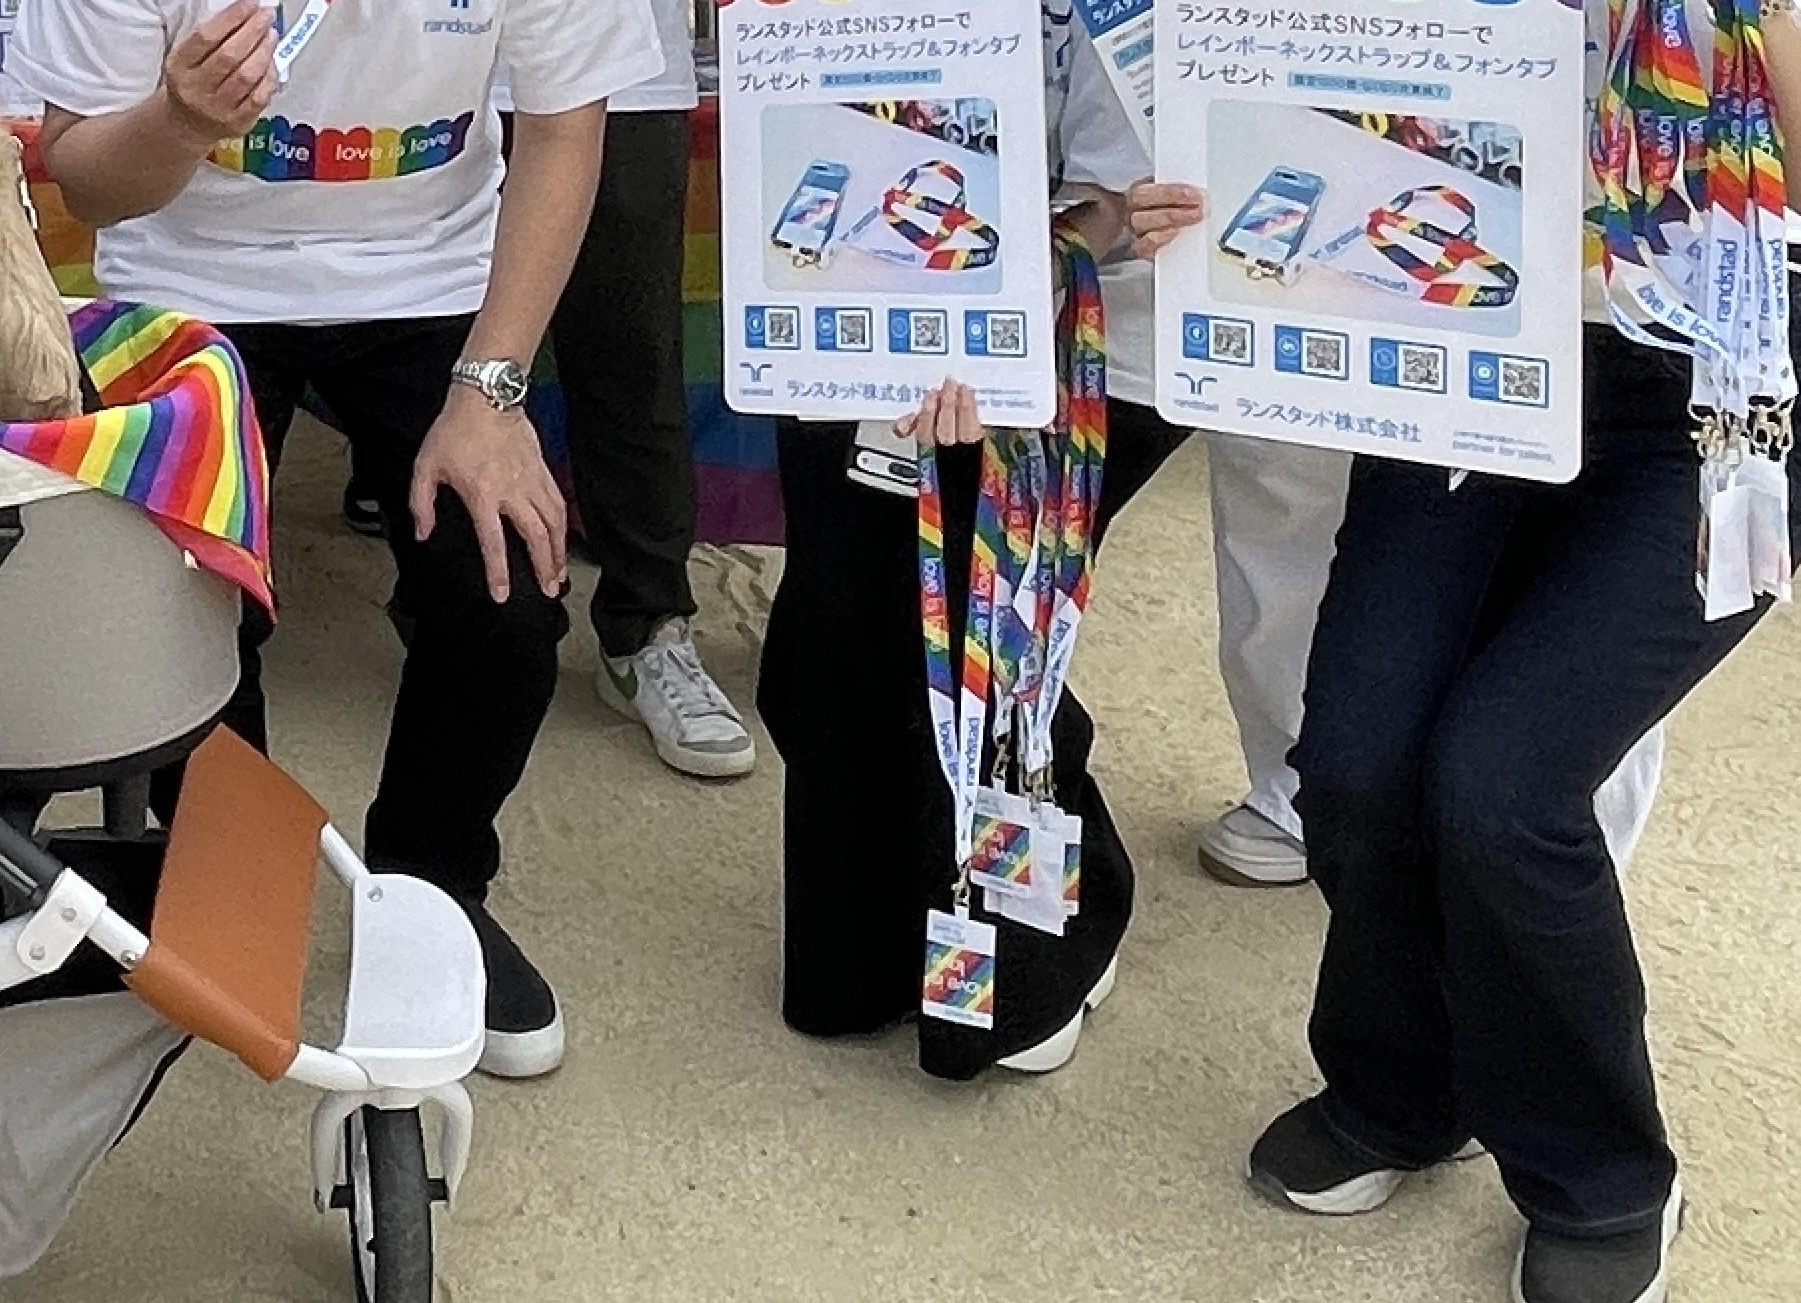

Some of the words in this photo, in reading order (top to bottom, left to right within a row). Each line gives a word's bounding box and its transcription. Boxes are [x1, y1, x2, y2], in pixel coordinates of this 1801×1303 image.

[736, 11, 971, 42] ランスタッド公式SNSフォローで
[1175, 3, 1494, 45] ランスタッド公式SNSフォローで
[736, 72, 811, 92] プレゼント
[1176, 59, 1275, 87] プレゼント
[249, 134, 265, 149] is
[269, 132, 311, 163] love
[336, 143, 383, 162] love
[410, 131, 452, 153] love
[1713, 238, 1738, 323] randstad
[1236, 397, 1422, 443] ランスタッド株式会社
